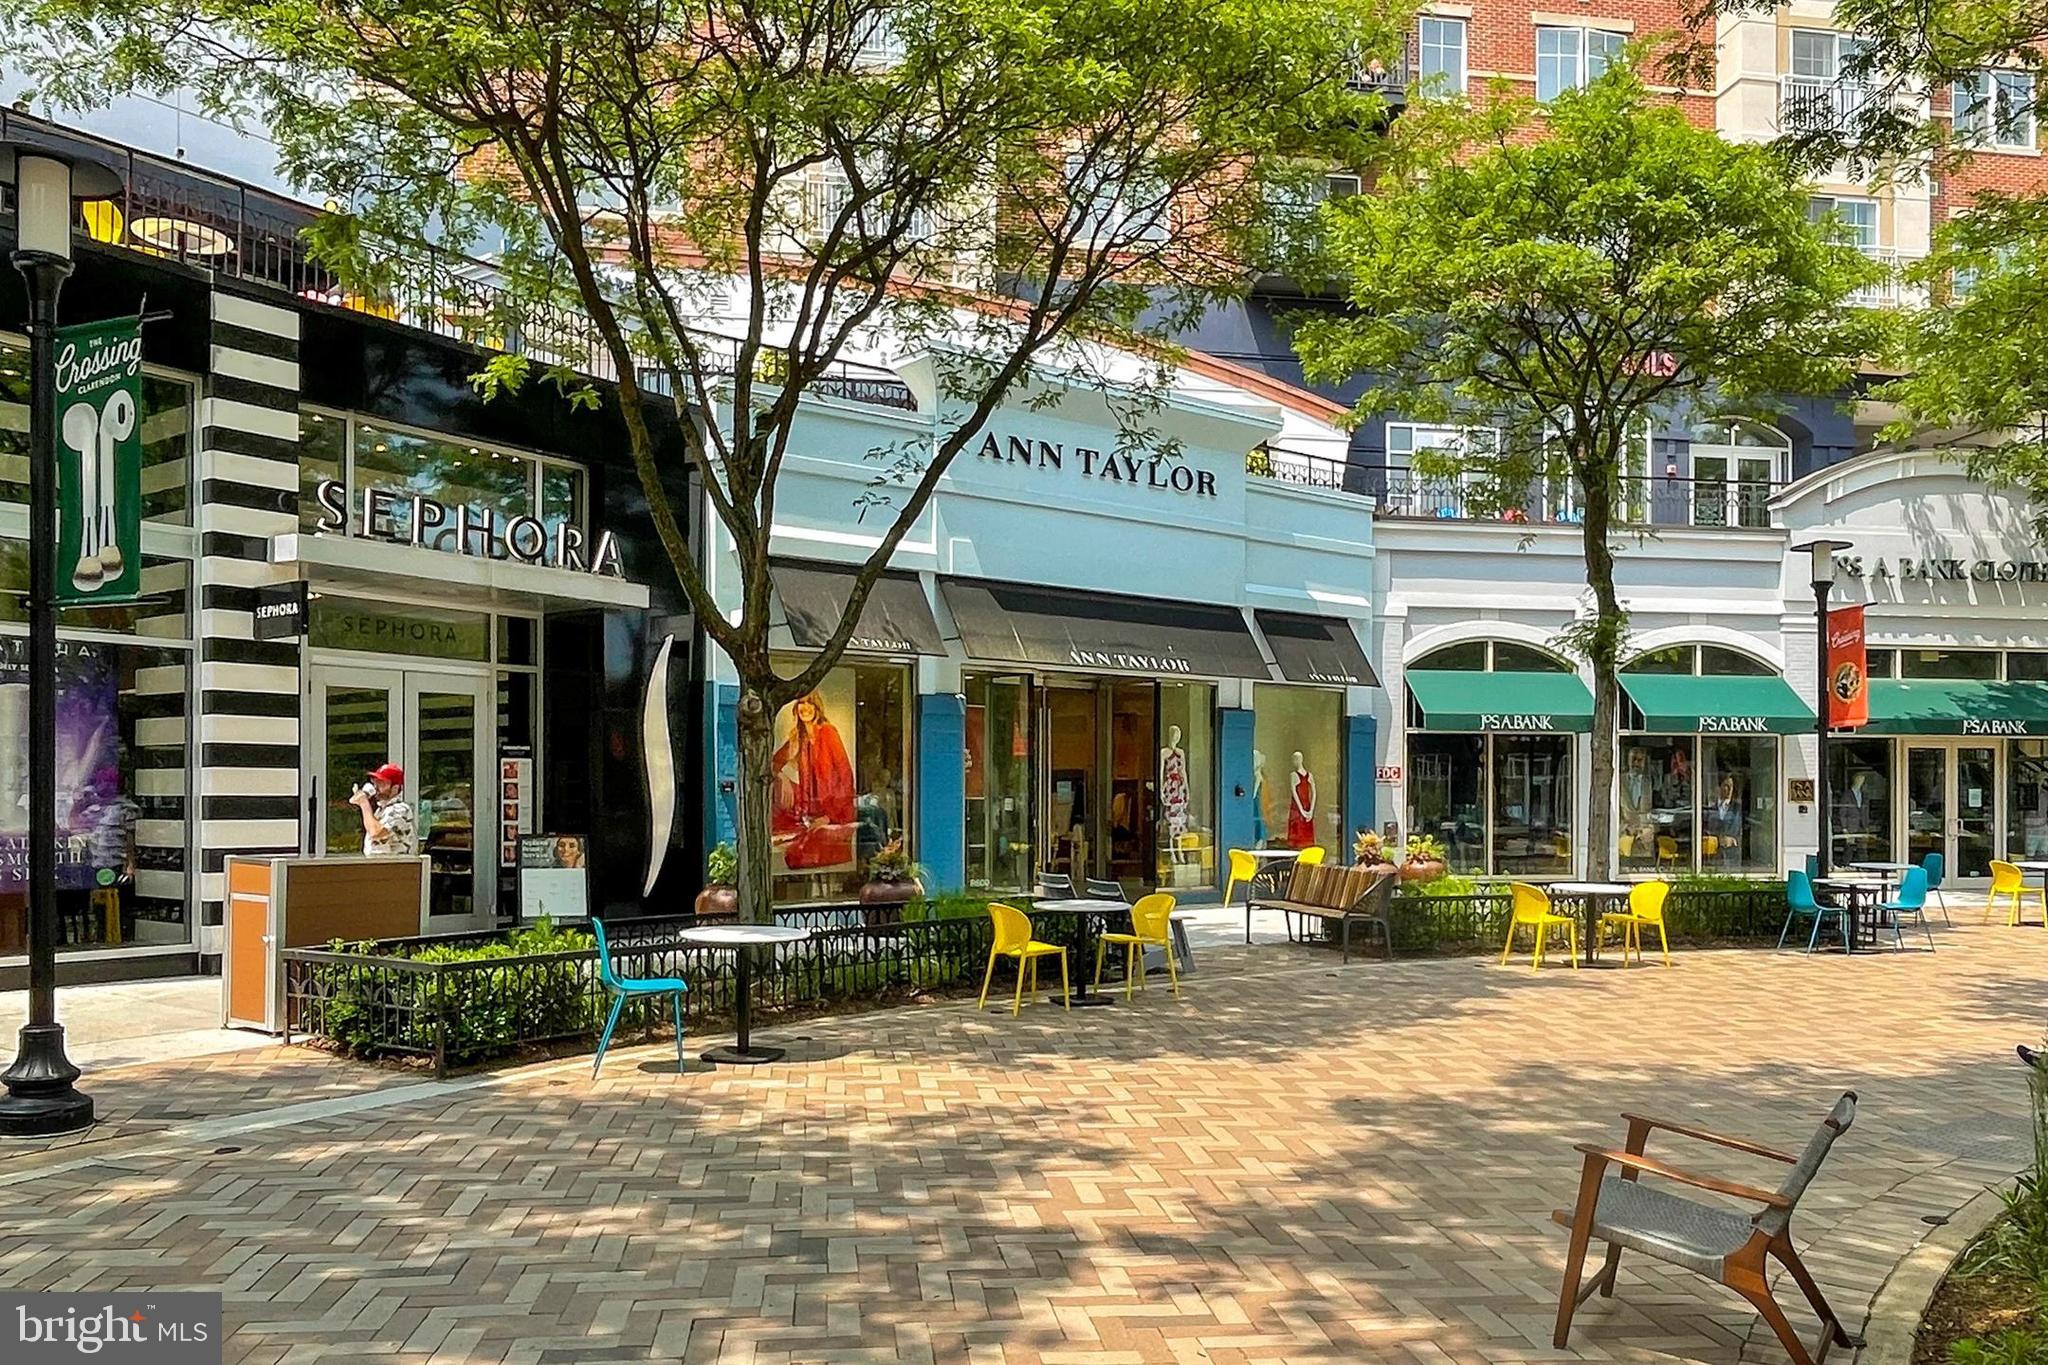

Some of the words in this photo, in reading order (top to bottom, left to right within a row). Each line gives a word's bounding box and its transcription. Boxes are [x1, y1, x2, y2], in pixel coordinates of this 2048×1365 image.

[55, 337, 142, 393] Crossing
[978, 431, 1063, 469] ANN
[1075, 447, 1217, 496] TAYLOR
[316, 480, 627, 579] SEPHORA
[1898, 558, 1969, 579] BANK
[256, 603, 299, 618] SEPHORA
[343, 615, 458, 643] SEPHORA
[1070, 650, 1112, 666] ANN
[1113, 653, 1190, 673] TAYLOR
[1514, 715, 1553, 730] BANK
[1730, 717, 1768, 731] BANK
[1992, 720, 2027, 734] BANK
[1376, 767, 1399, 779] FDC
